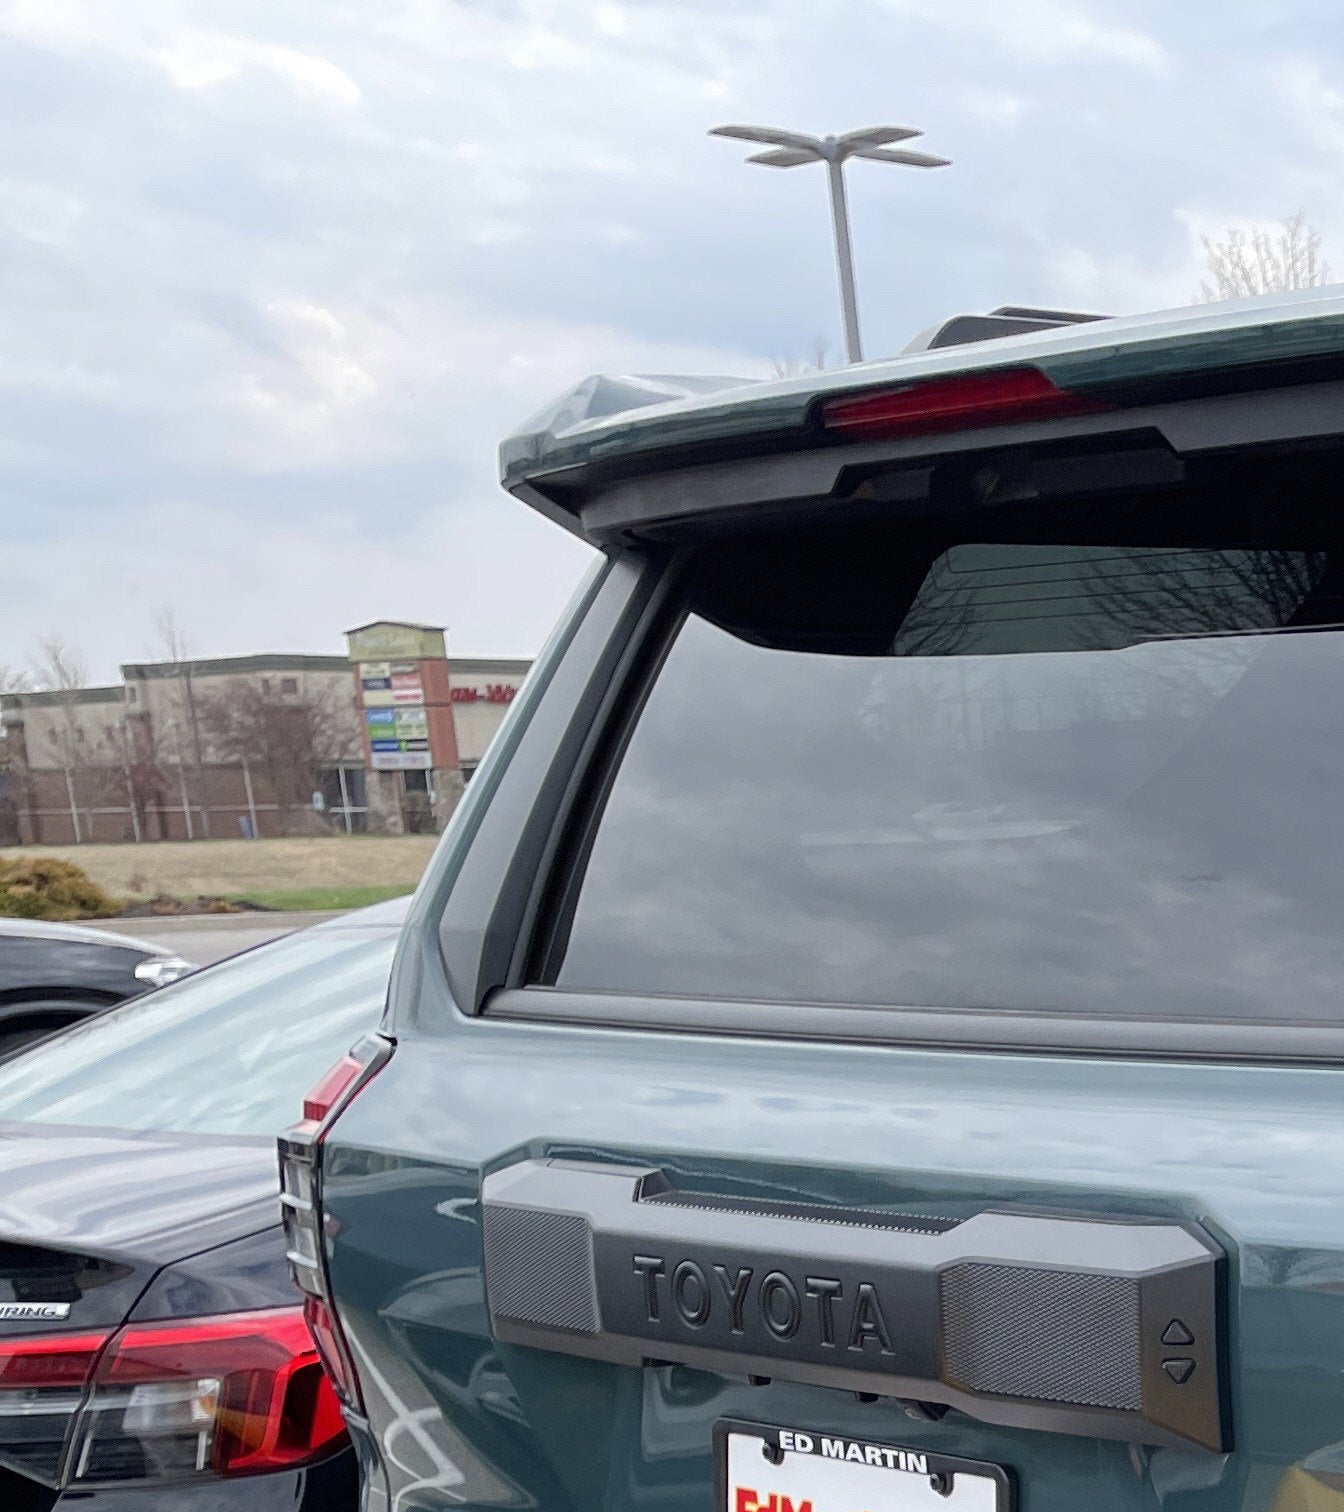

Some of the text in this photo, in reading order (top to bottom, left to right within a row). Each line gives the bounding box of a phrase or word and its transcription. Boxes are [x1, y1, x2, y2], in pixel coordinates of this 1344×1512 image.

[632, 1254, 896, 1356] TOYOTA
[778, 1430, 929, 1474] ED MARTIN
